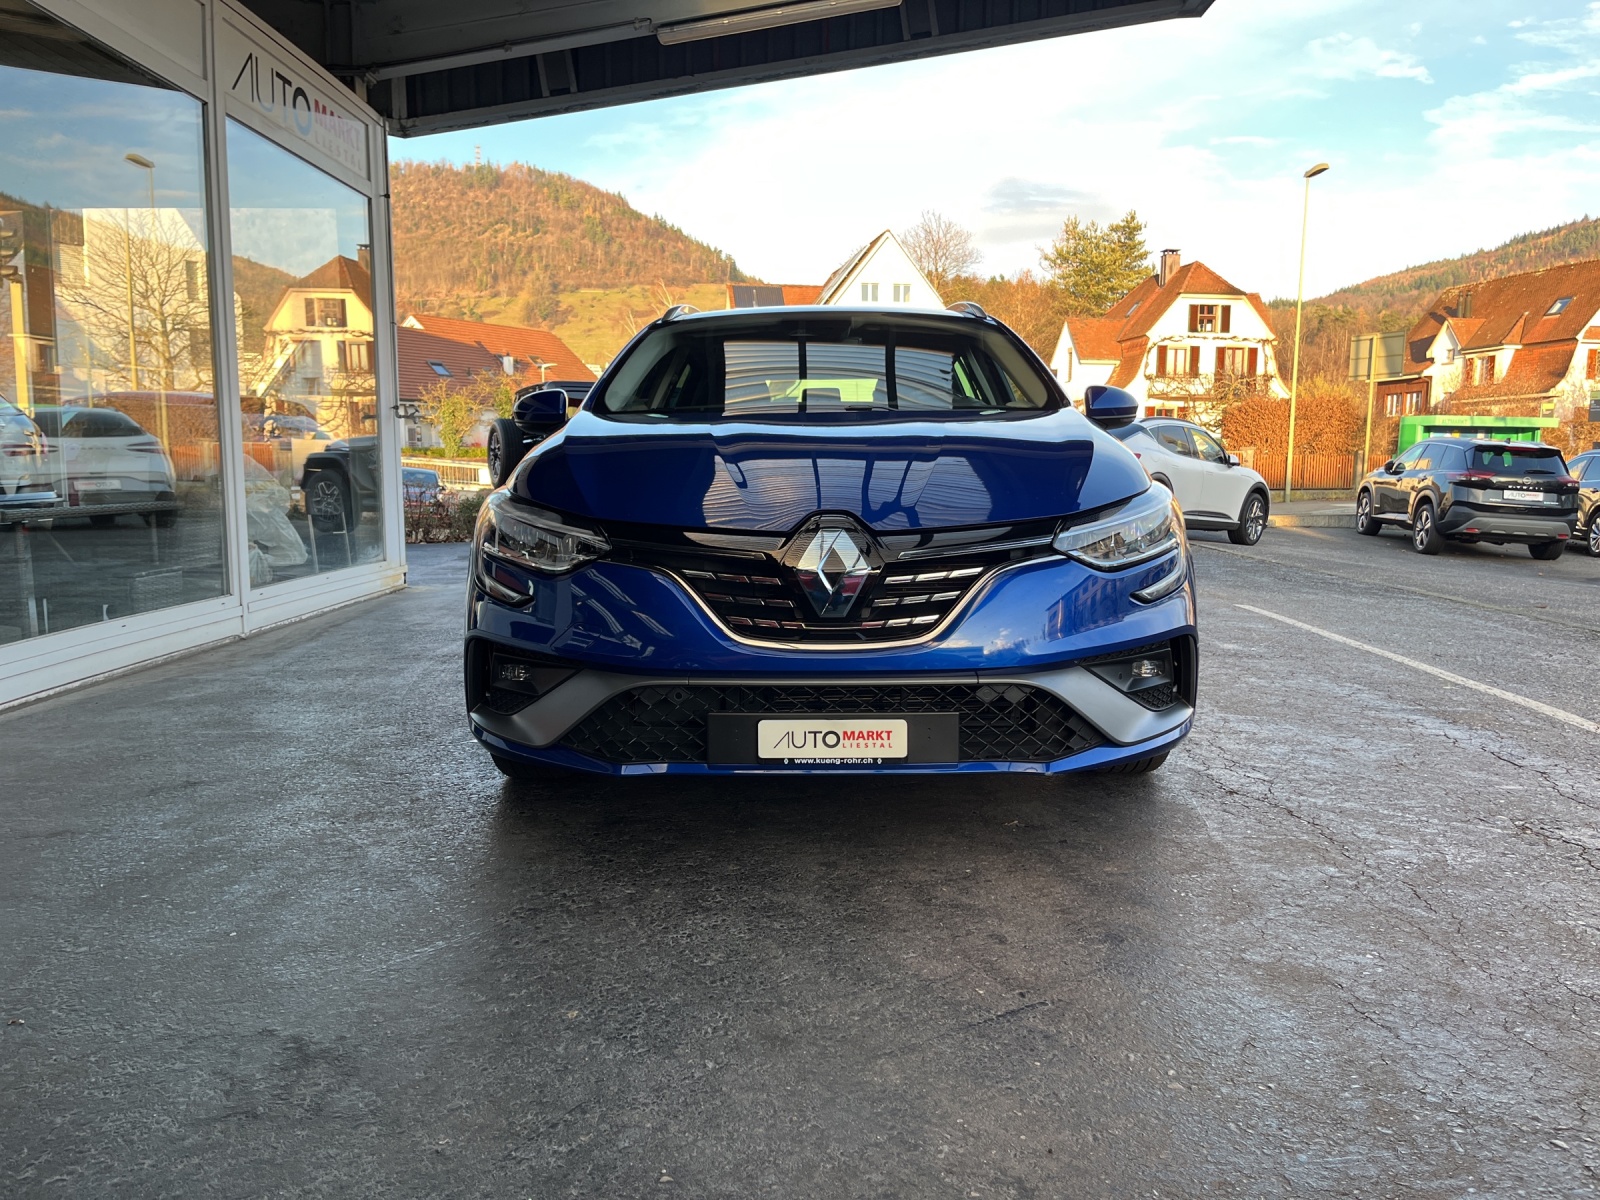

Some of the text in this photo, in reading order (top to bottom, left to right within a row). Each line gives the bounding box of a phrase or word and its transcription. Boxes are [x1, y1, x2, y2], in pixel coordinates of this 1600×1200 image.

[231, 52, 313, 137] AUTO
[773, 730, 893, 749] AUTO MARKT
[794, 757, 874, 765] www.kueng-rohr.ch
